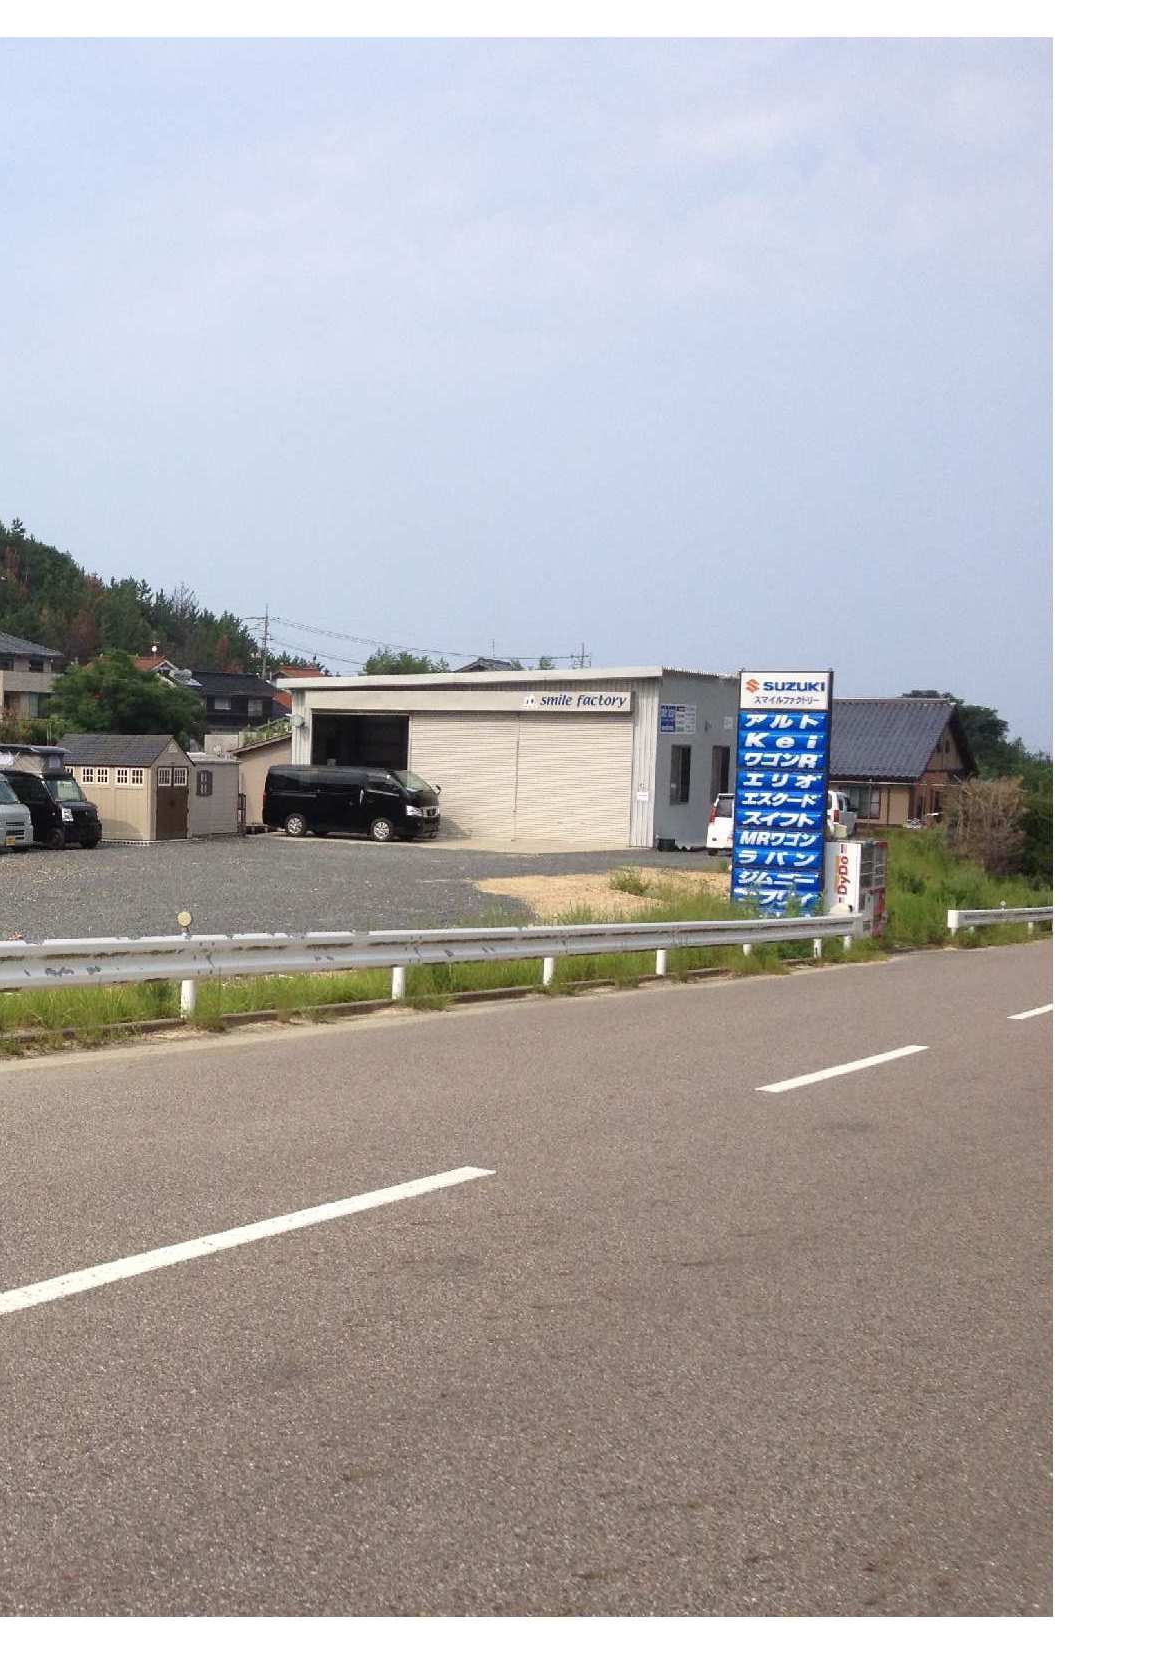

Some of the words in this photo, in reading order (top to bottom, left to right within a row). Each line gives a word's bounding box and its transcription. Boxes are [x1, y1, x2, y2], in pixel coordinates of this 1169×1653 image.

[763, 682, 825, 691] SUZUKI
[540, 694, 573, 706] smile
[577, 694, 627, 708] factory
[754, 696, 820, 704] スマイルファクトリー
[744, 714, 819, 729] アルト
[745, 732, 818, 748] Kei
[744, 752, 818, 768] ワゴンR
[743, 773, 817, 788] エリオ
[742, 792, 817, 808] エスクード
[742, 812, 814, 827] スイフト
[739, 831, 816, 847] MRワゴン
[738, 871, 815, 885] ジムニー
[837, 856, 851, 895] DyDo
